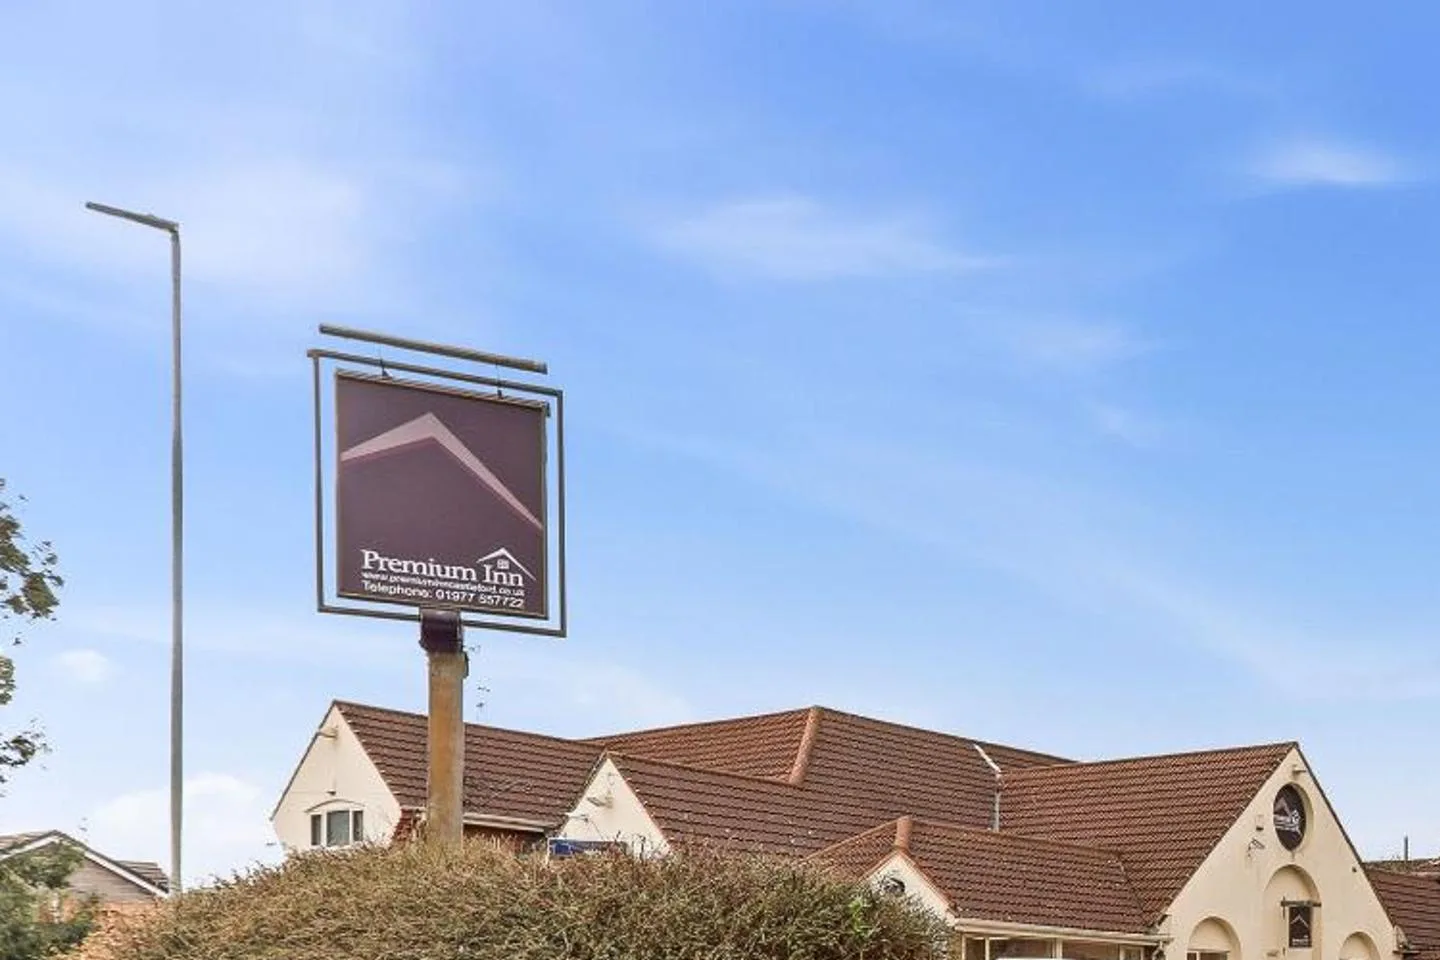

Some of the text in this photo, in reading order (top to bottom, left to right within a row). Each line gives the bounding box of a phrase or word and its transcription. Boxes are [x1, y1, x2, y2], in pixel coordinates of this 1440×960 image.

[361, 549, 524, 587] Premium Inn
[361, 580, 433, 599] Telephone:
[435, 588, 474, 603] 01977
